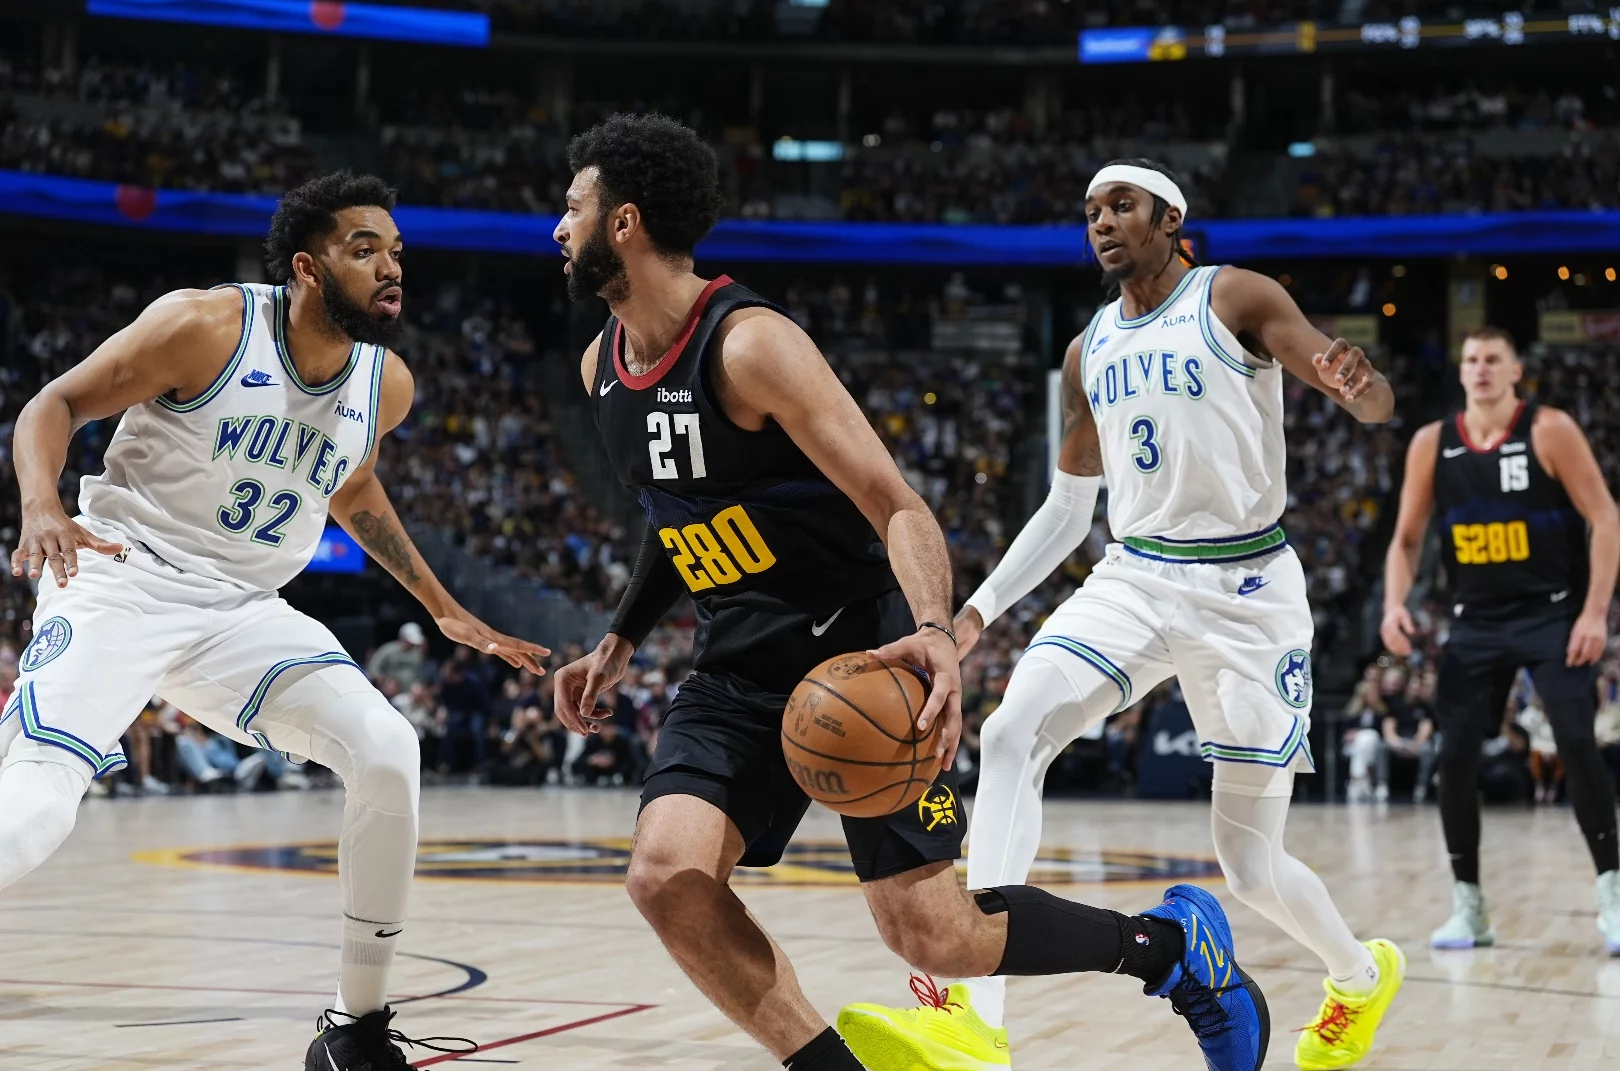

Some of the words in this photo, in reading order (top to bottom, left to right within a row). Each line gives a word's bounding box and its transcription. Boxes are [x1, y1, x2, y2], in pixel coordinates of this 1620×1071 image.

[1088, 349, 1206, 417] WOLVES
[212, 414, 350, 499] WOLVES
[646, 411, 707, 480] 27
[1129, 415, 1163, 475] 3
[1498, 454, 1529, 493] 15
[216, 477, 302, 548] 32
[1452, 520, 1530, 564] 5280
